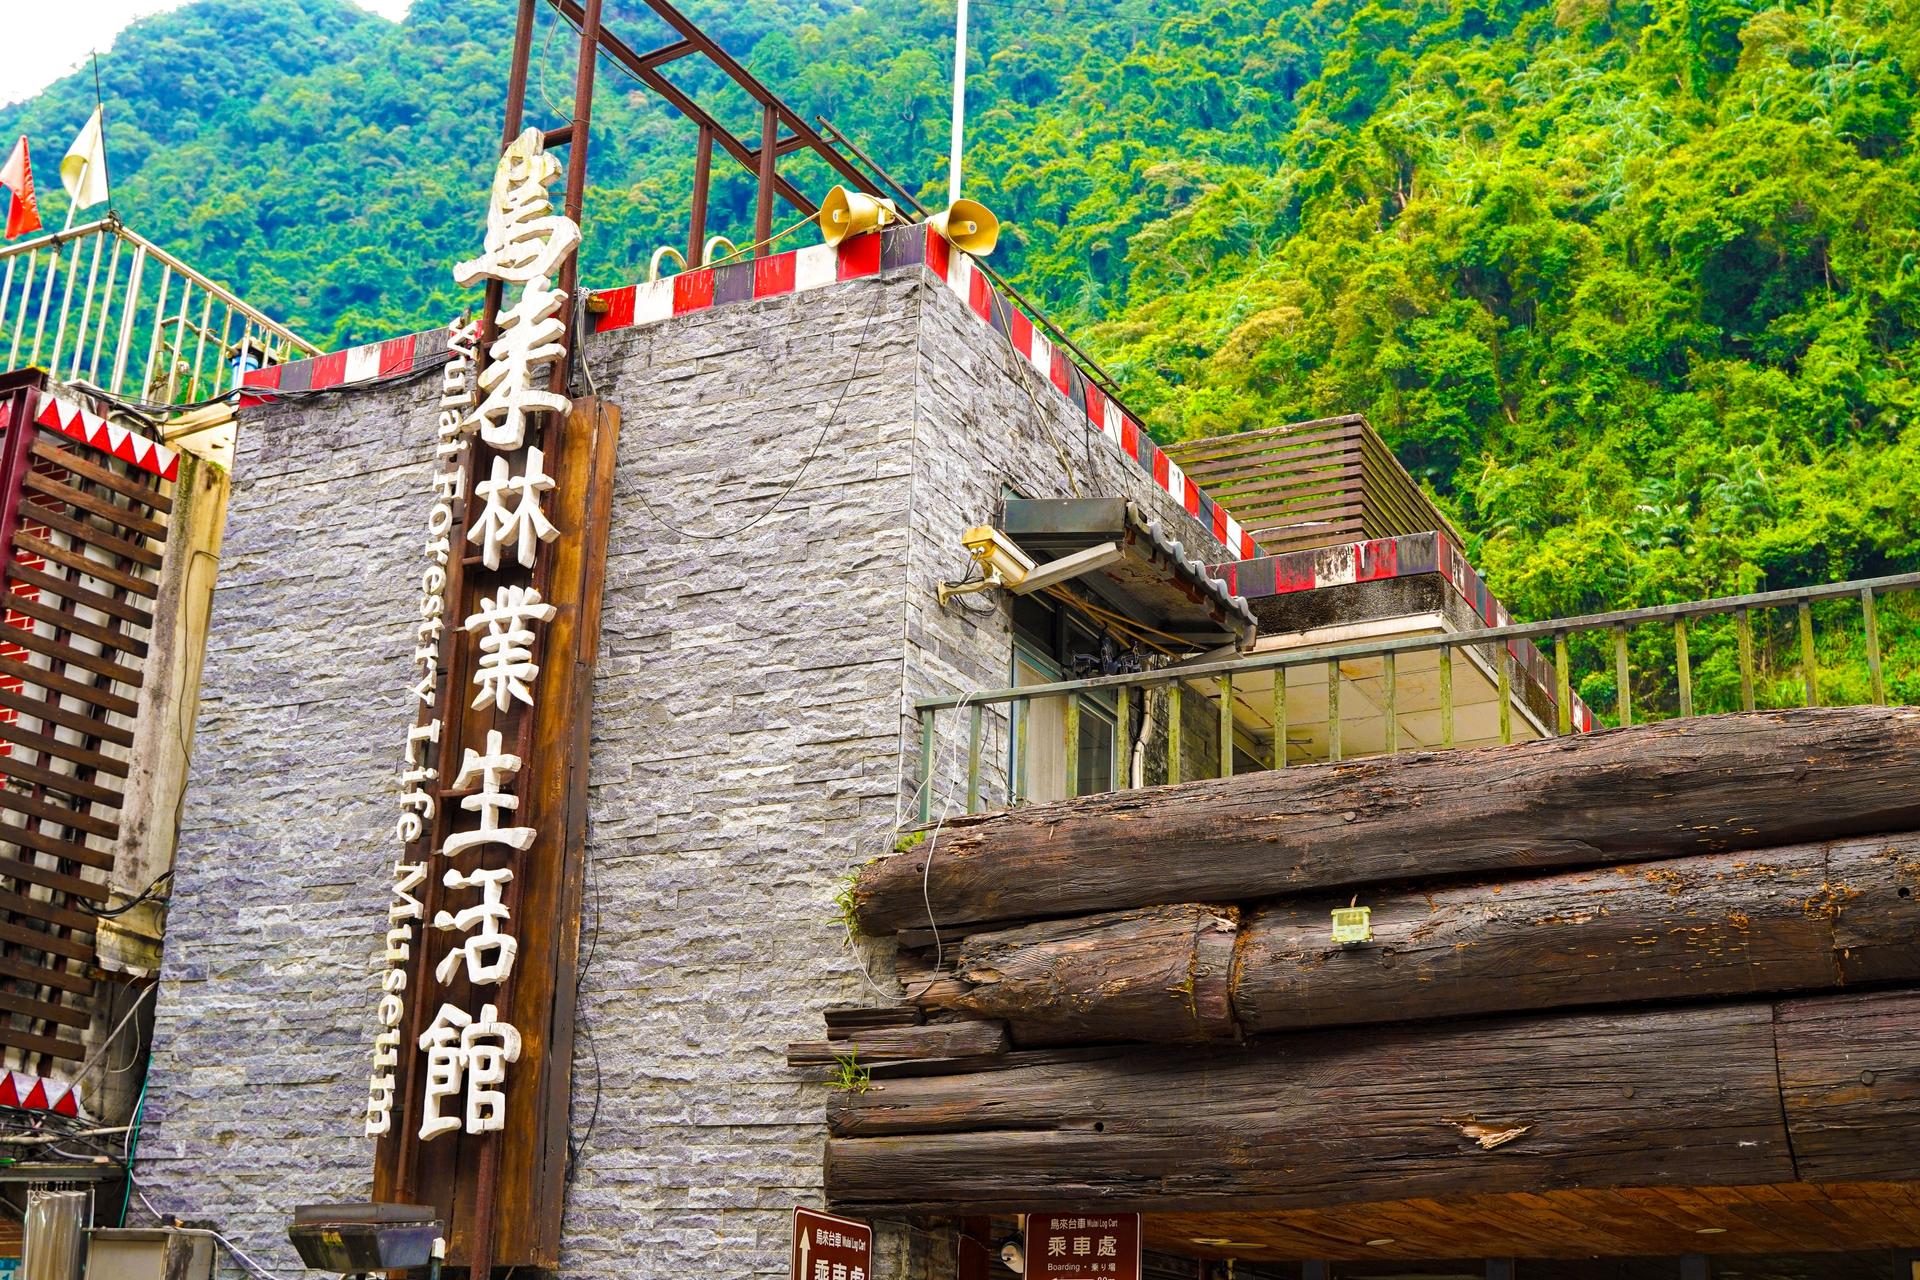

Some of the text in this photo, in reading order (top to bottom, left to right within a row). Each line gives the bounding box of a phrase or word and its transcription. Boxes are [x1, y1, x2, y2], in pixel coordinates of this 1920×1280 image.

[365, 316, 484, 1139] Wulai Forestry Life Museum
[1047, 1235, 1117, 1257] 乘車處
[1047, 1263, 1080, 1273] Boarding
